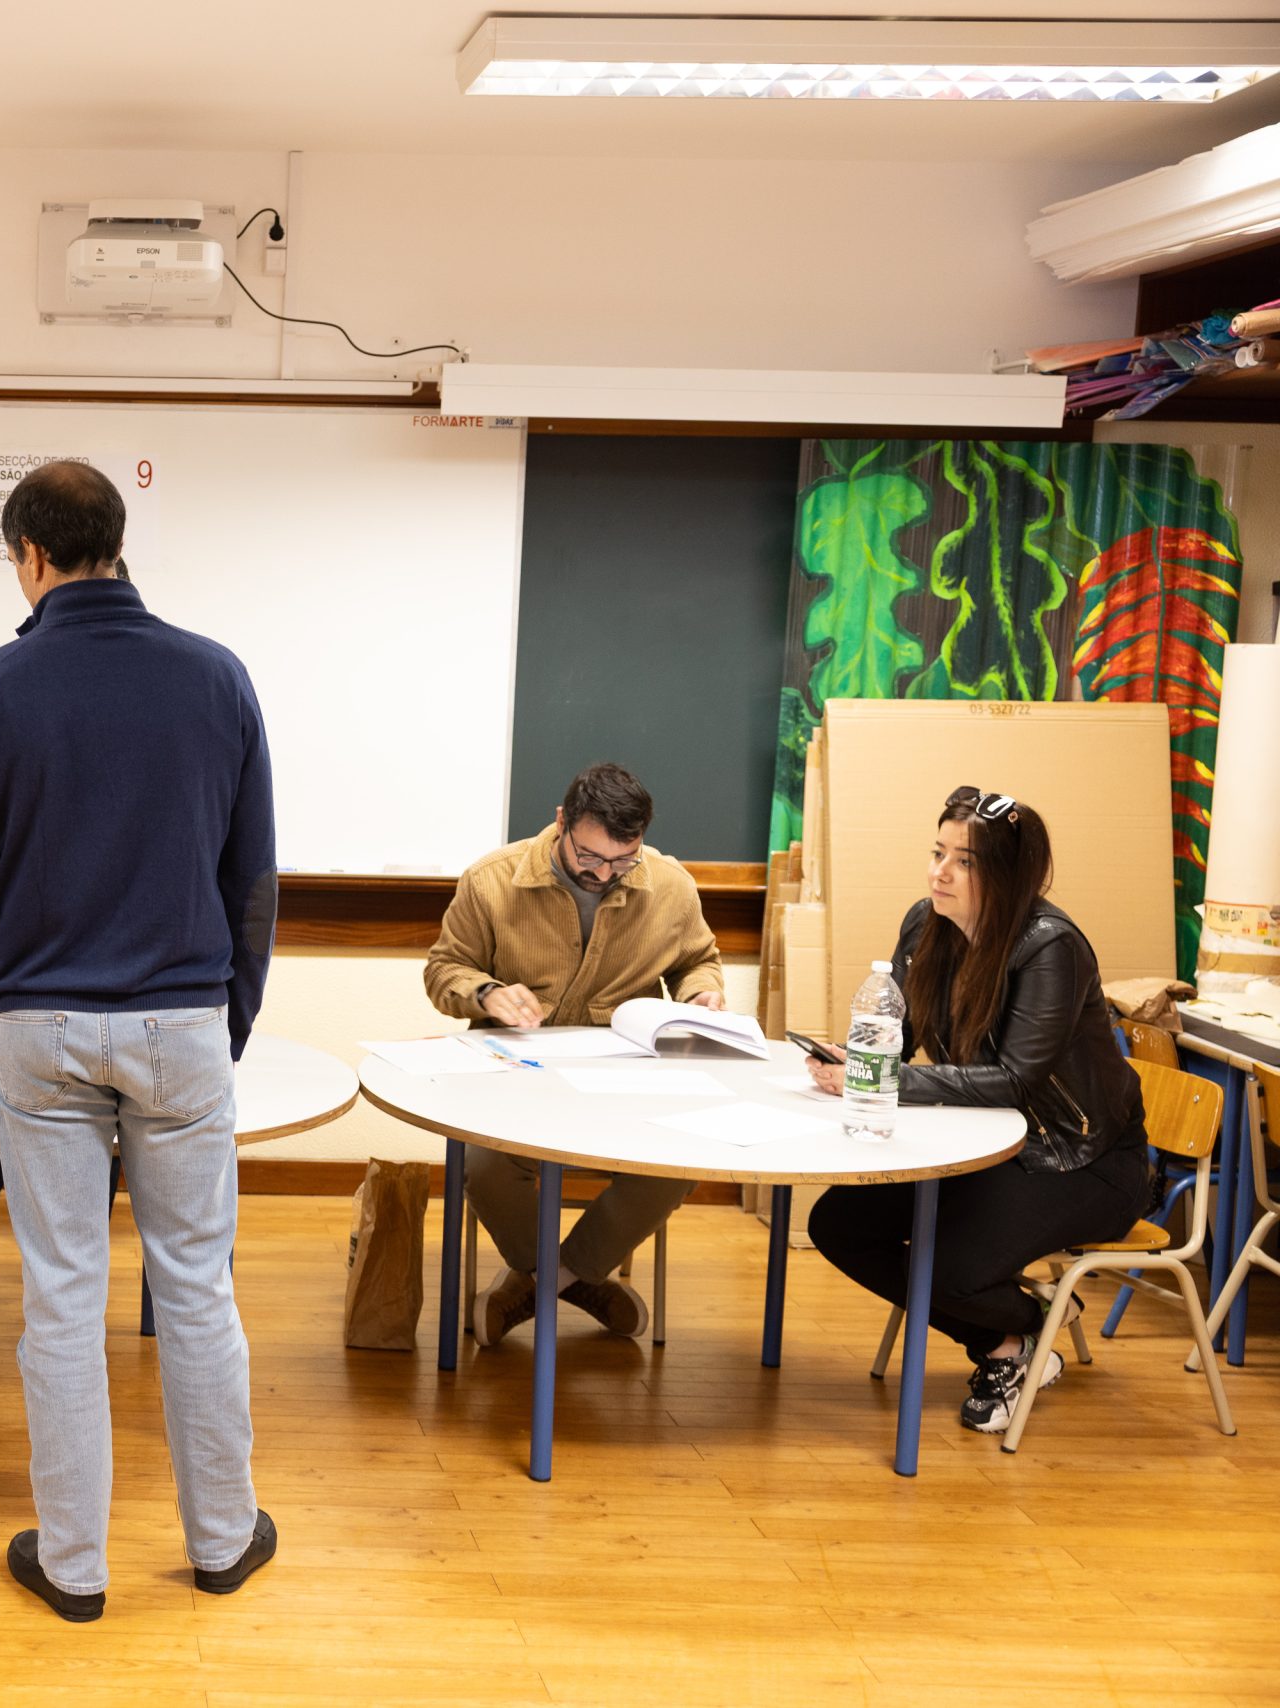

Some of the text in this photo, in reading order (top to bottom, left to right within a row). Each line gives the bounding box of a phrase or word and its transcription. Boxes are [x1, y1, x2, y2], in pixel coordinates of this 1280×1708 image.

[136, 247, 161, 255] EPSON
[412, 415, 484, 428] FORMARTE
[0, 468, 22, 481] SÃO
[137, 460, 153, 489] 9
